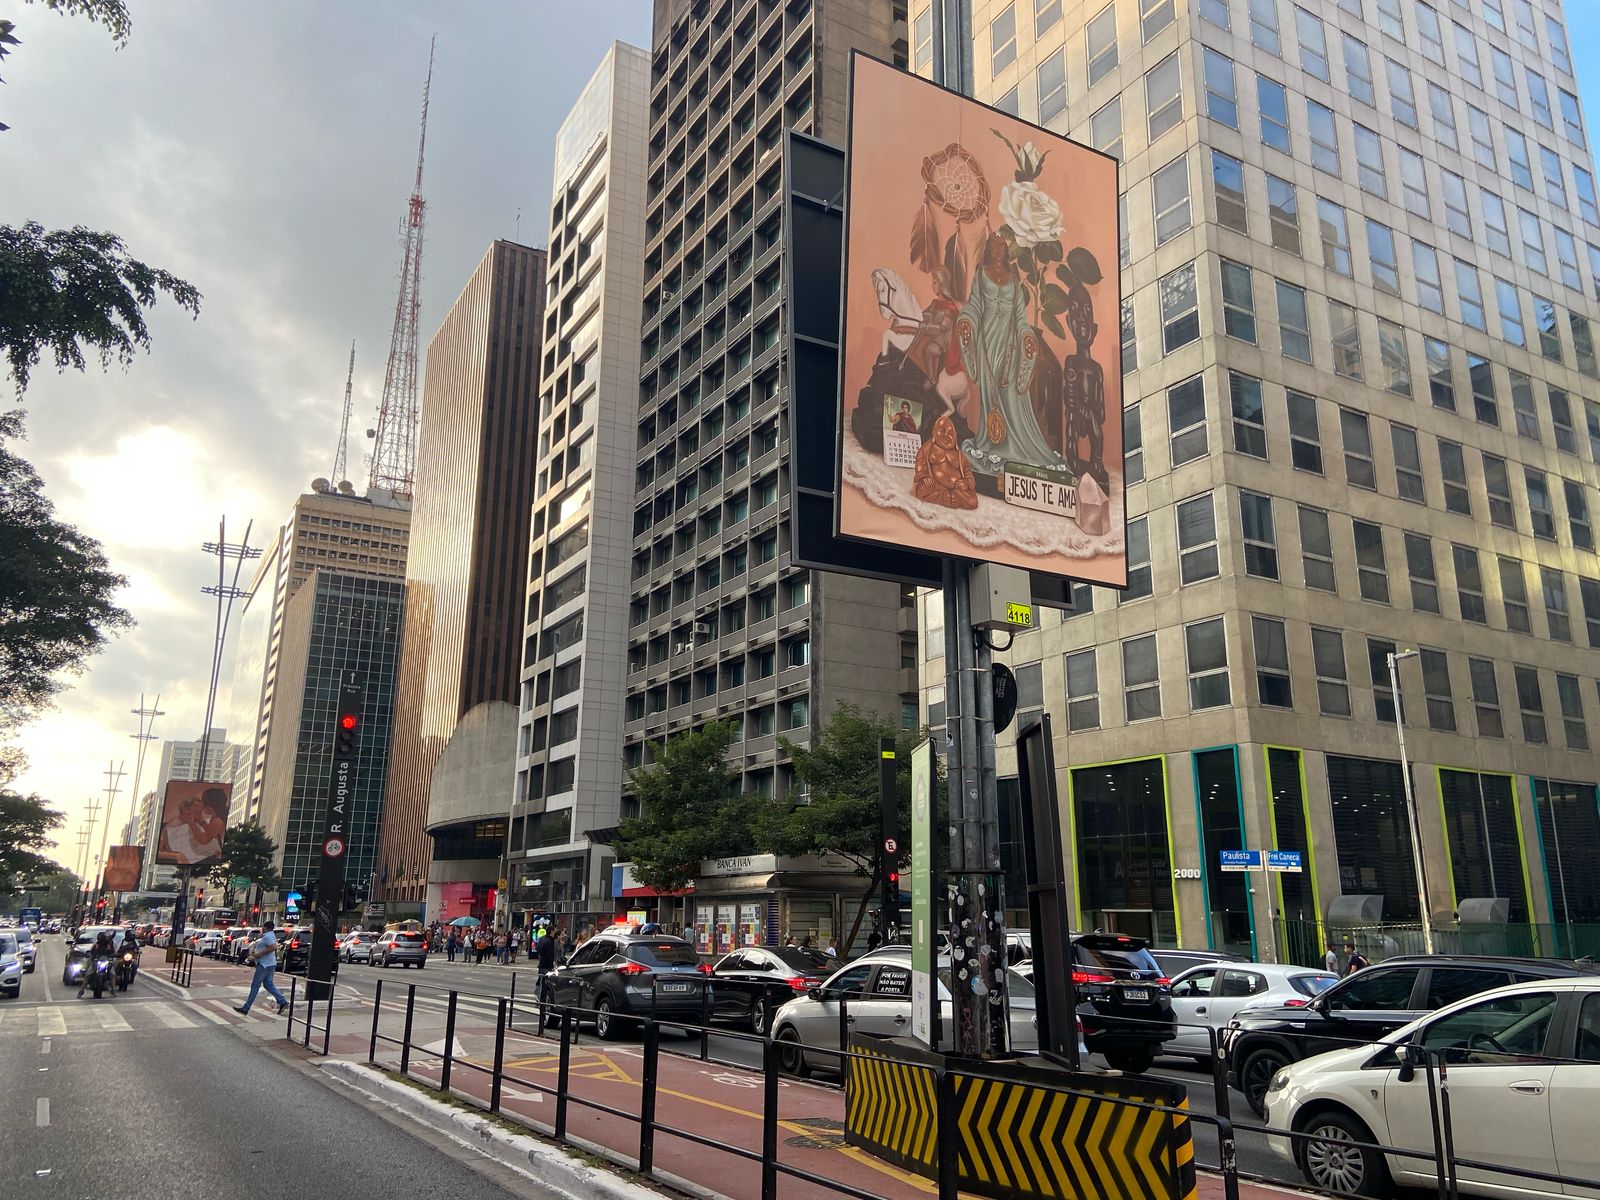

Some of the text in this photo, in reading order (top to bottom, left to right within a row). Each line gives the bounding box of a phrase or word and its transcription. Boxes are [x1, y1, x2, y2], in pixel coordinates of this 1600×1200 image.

[1008, 476, 1076, 509] JESUS TE AMA
[1009, 610, 1030, 623] 4118
[330, 762, 349, 833] R. Augusta
[1223, 851, 1250, 860] Paulista
[1268, 852, 1300, 861] Frei Caneca
[717, 857, 752, 869] BANCA IVAN
[1174, 868, 1201, 878] 2000
